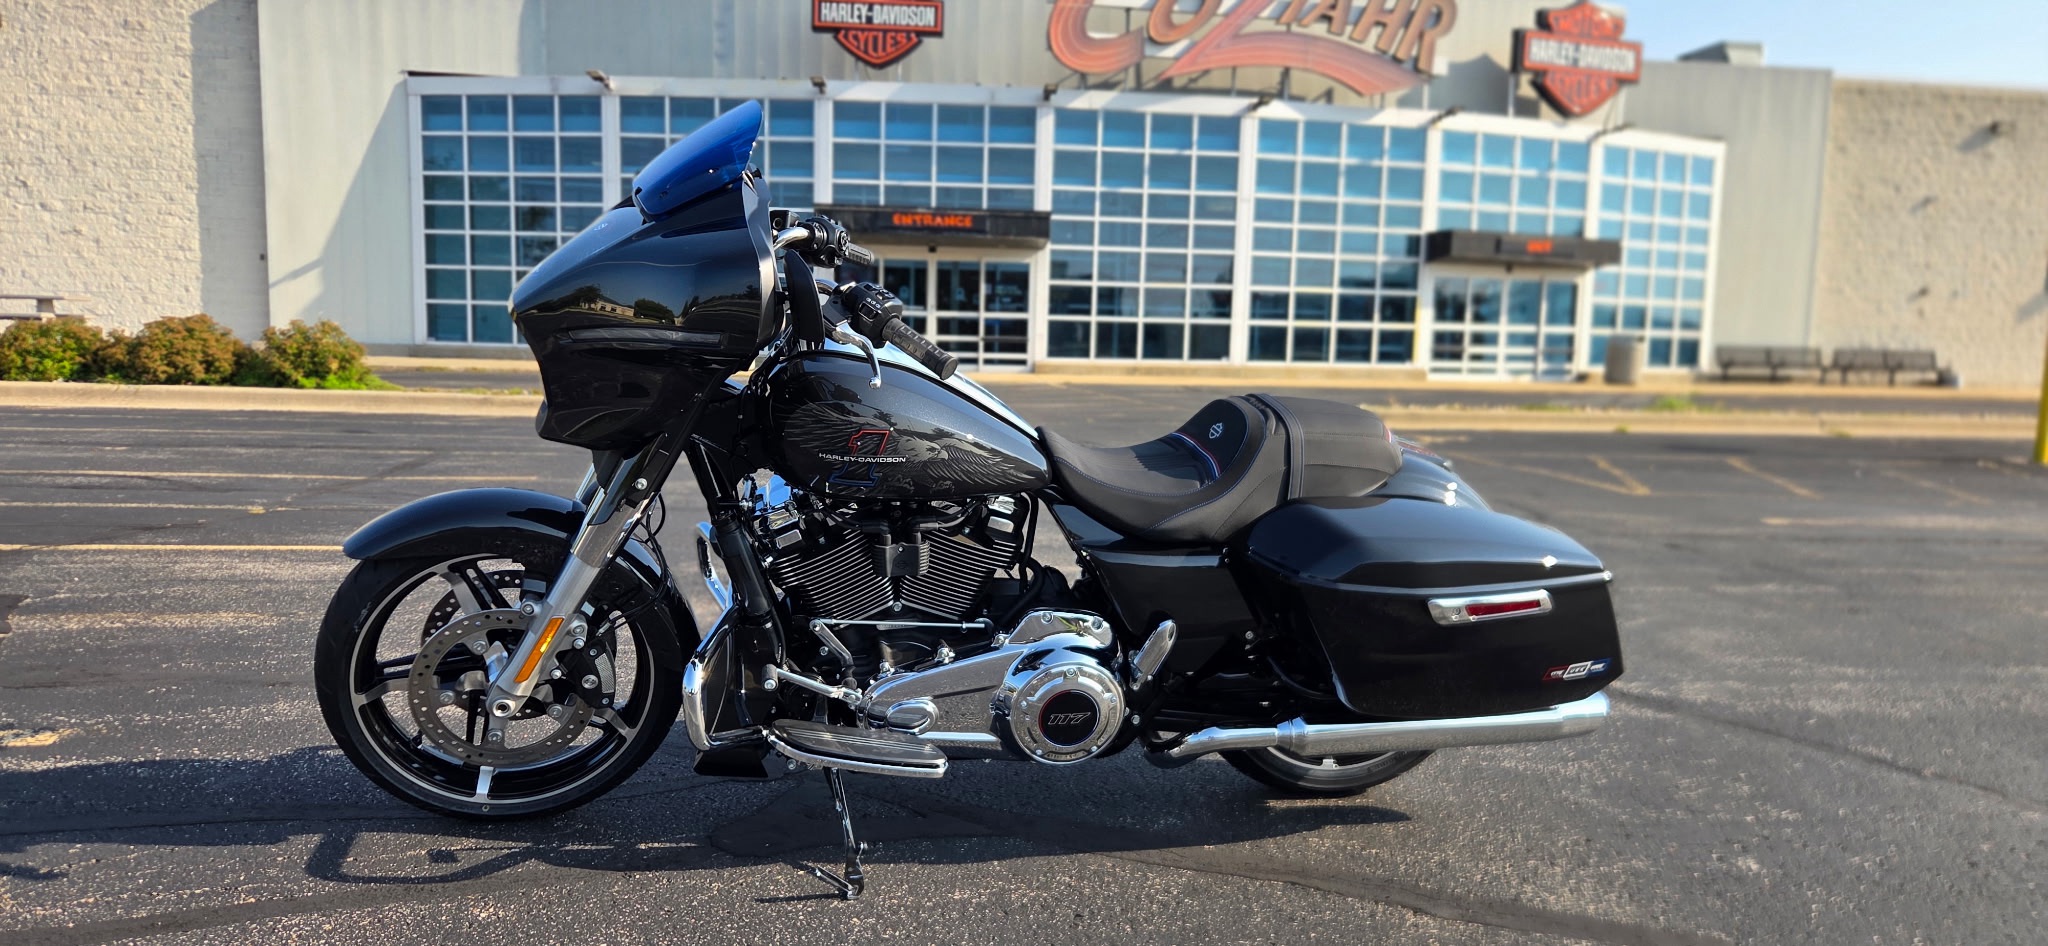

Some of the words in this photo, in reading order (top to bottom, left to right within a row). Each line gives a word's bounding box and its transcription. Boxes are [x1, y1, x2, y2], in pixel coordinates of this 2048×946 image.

[820, 2, 936, 27] HARLEY-DAVIDSON
[847, 30, 908, 57] CYCLES
[1528, 38, 1637, 73] HARLEY-DAVIDSON
[892, 212, 973, 228] ENTRANCE
[818, 452, 907, 463] HARLEY-DAVIDSON
[1048, 712, 1091, 725] 117
